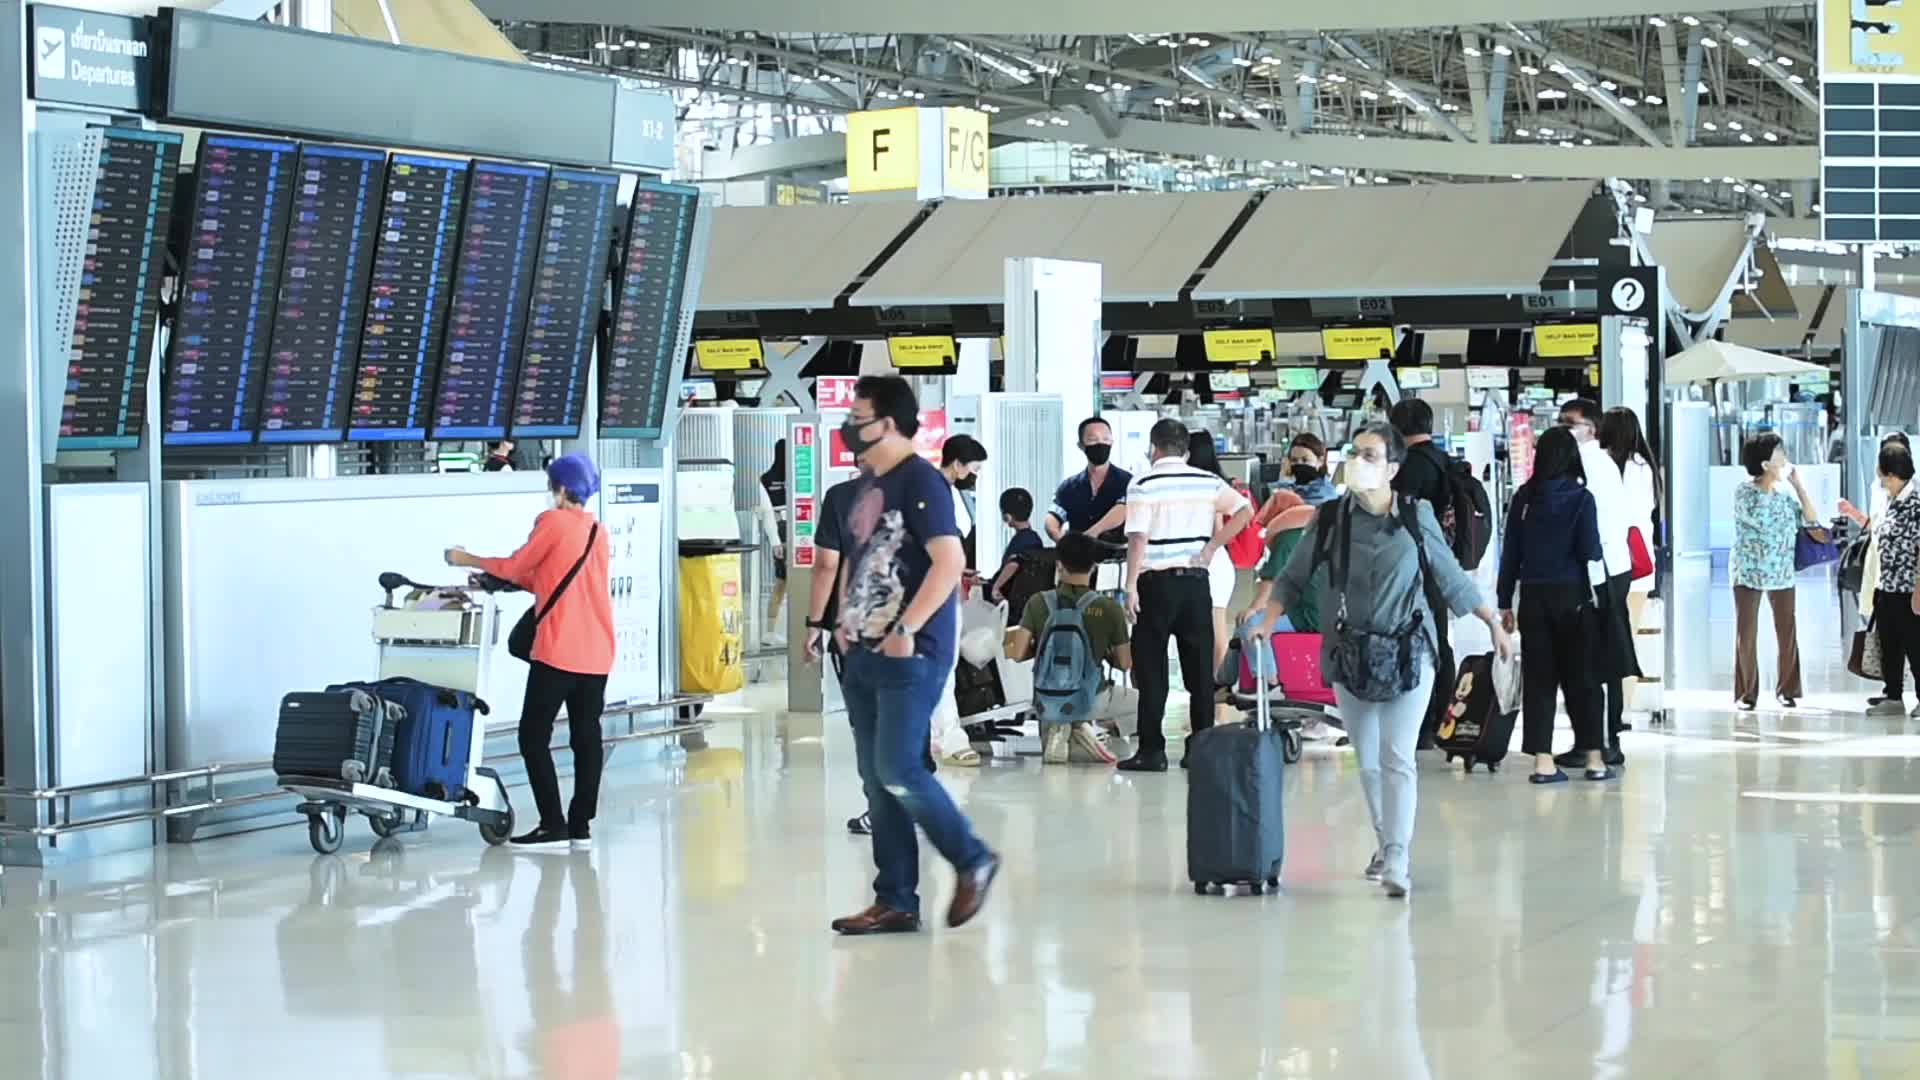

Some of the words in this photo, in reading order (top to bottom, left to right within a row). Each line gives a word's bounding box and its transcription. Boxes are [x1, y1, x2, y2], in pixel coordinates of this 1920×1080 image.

[71, 59, 135, 88] Departures
[872, 129, 890, 171] F
[949, 127, 985, 173] F/G
[1527, 295, 1555, 308] E01
